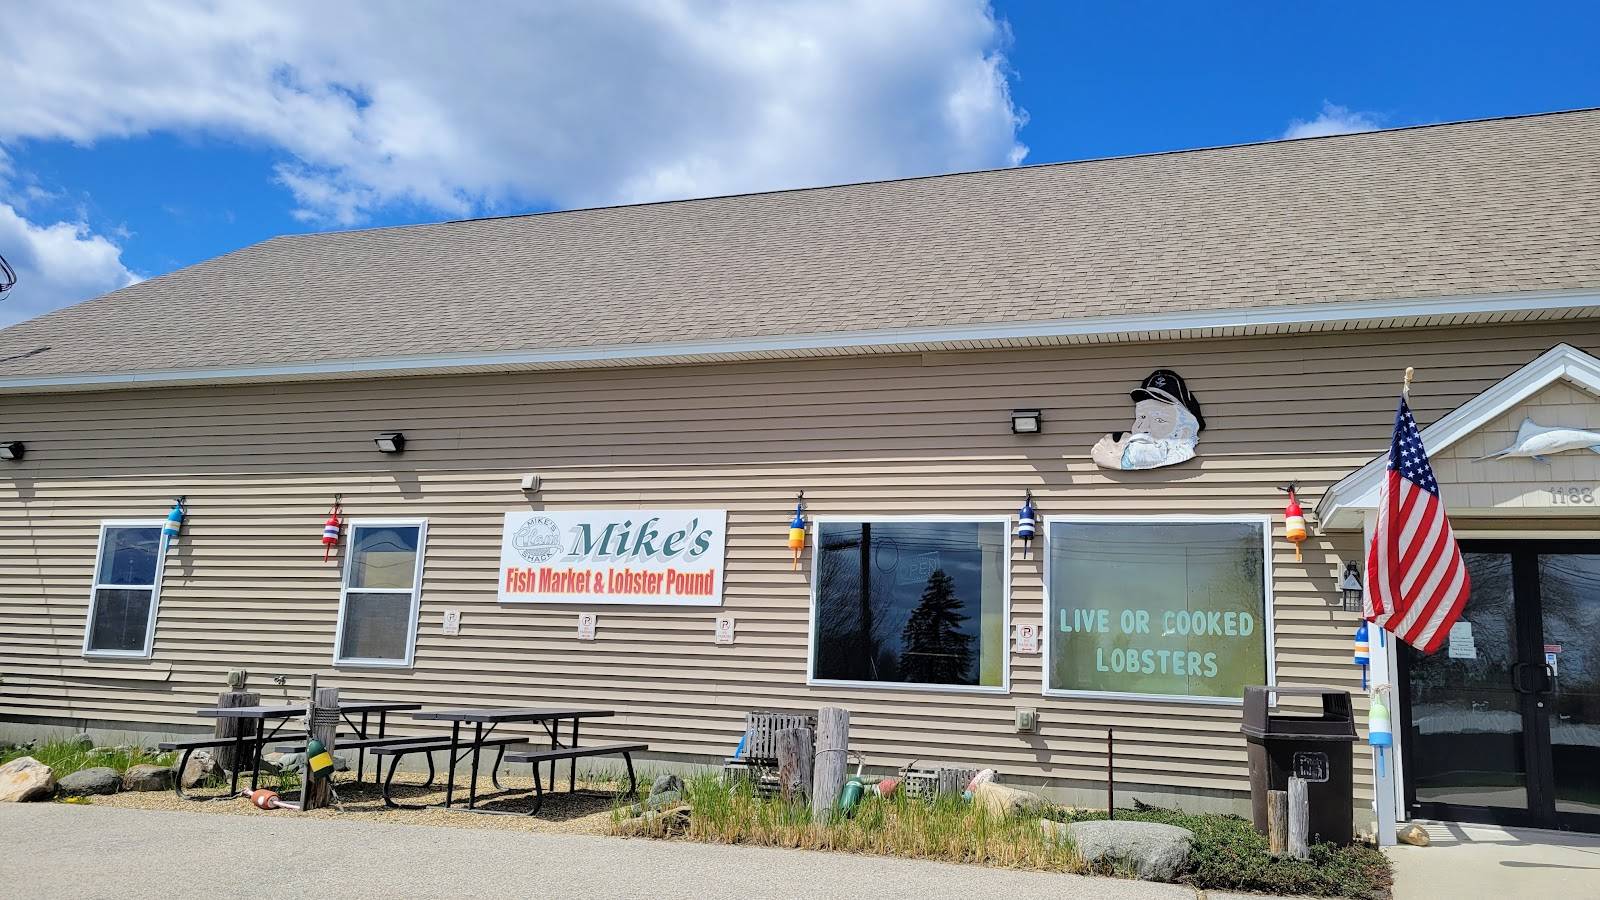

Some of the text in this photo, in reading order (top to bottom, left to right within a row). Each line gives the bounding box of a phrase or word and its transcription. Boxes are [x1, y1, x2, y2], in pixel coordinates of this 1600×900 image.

[1550, 486, 1595, 504] 1188
[526, 517, 557, 533] MIKE'S
[568, 517, 713, 557] Mike's
[521, 550, 553, 563] SHACK
[506, 568, 715, 596] Fish Market & Lobster Pound
[1060, 608, 1254, 637] LIVE OR COOKED
[1096, 647, 1218, 678] LOBSTERS
